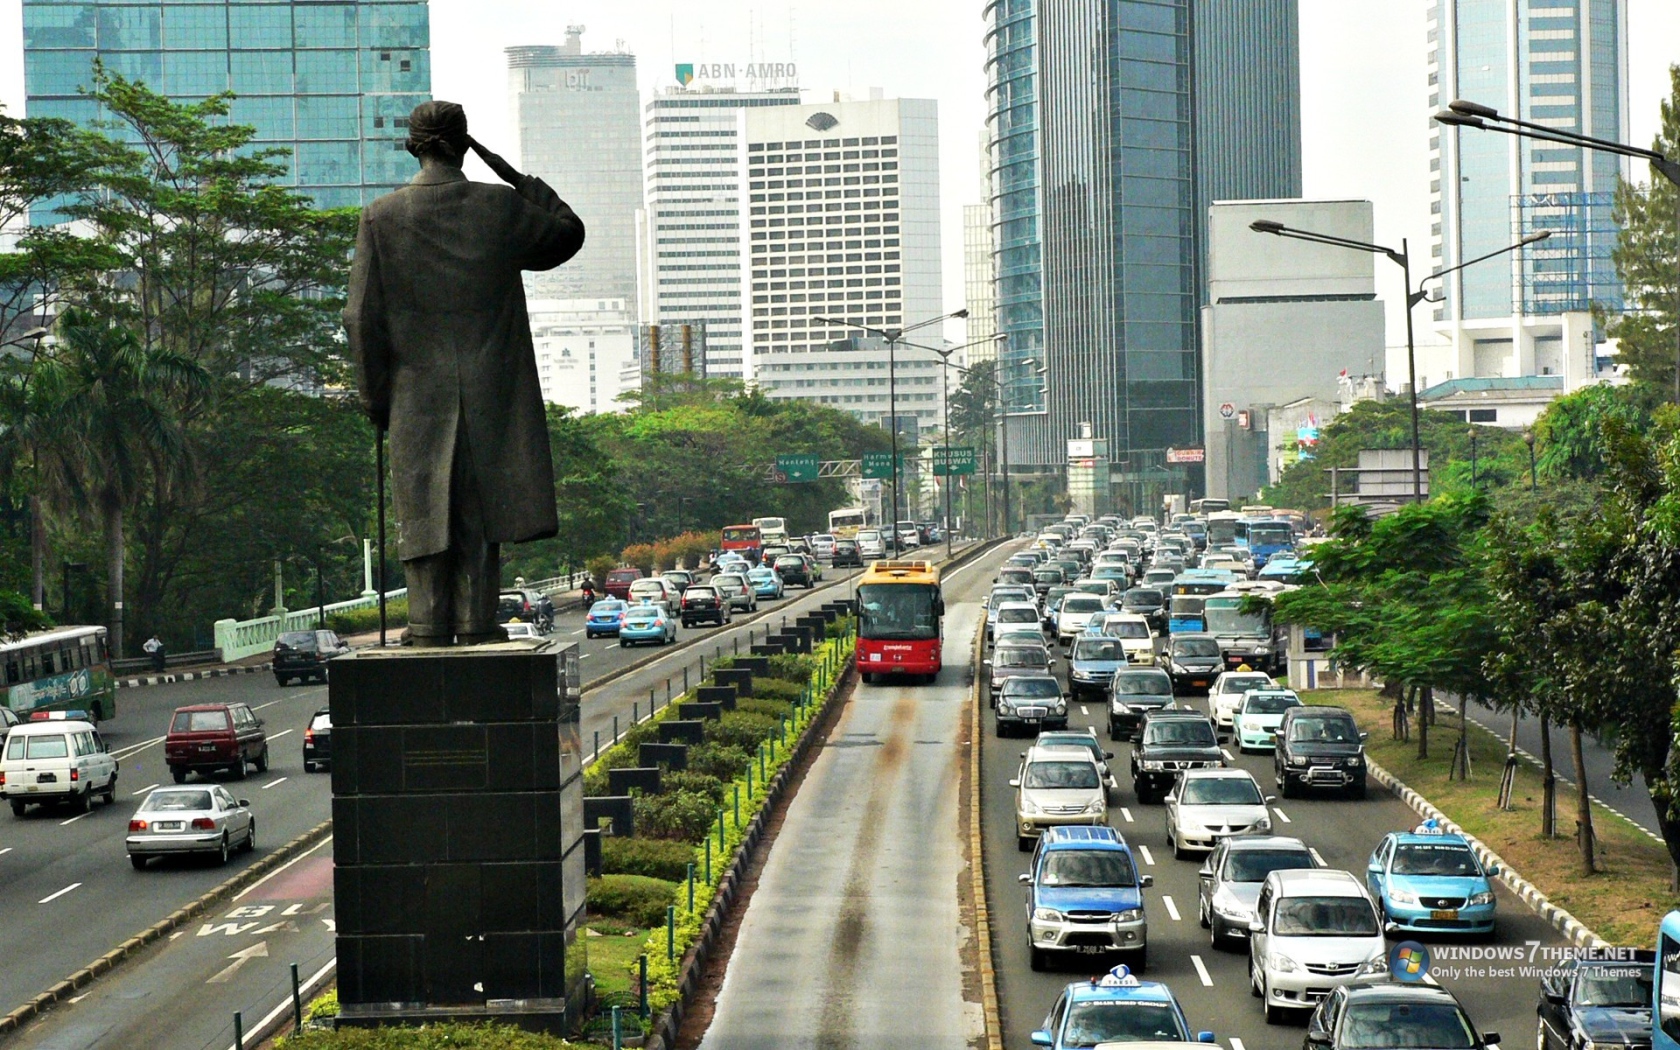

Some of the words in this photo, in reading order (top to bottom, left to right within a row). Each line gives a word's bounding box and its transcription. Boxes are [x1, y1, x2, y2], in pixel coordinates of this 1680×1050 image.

[745, 62, 797, 78] AMRO
[934, 450, 972, 458] KHUSUS
[778, 459, 815, 467] Menteng
[934, 458, 972, 466] BUSWAY
